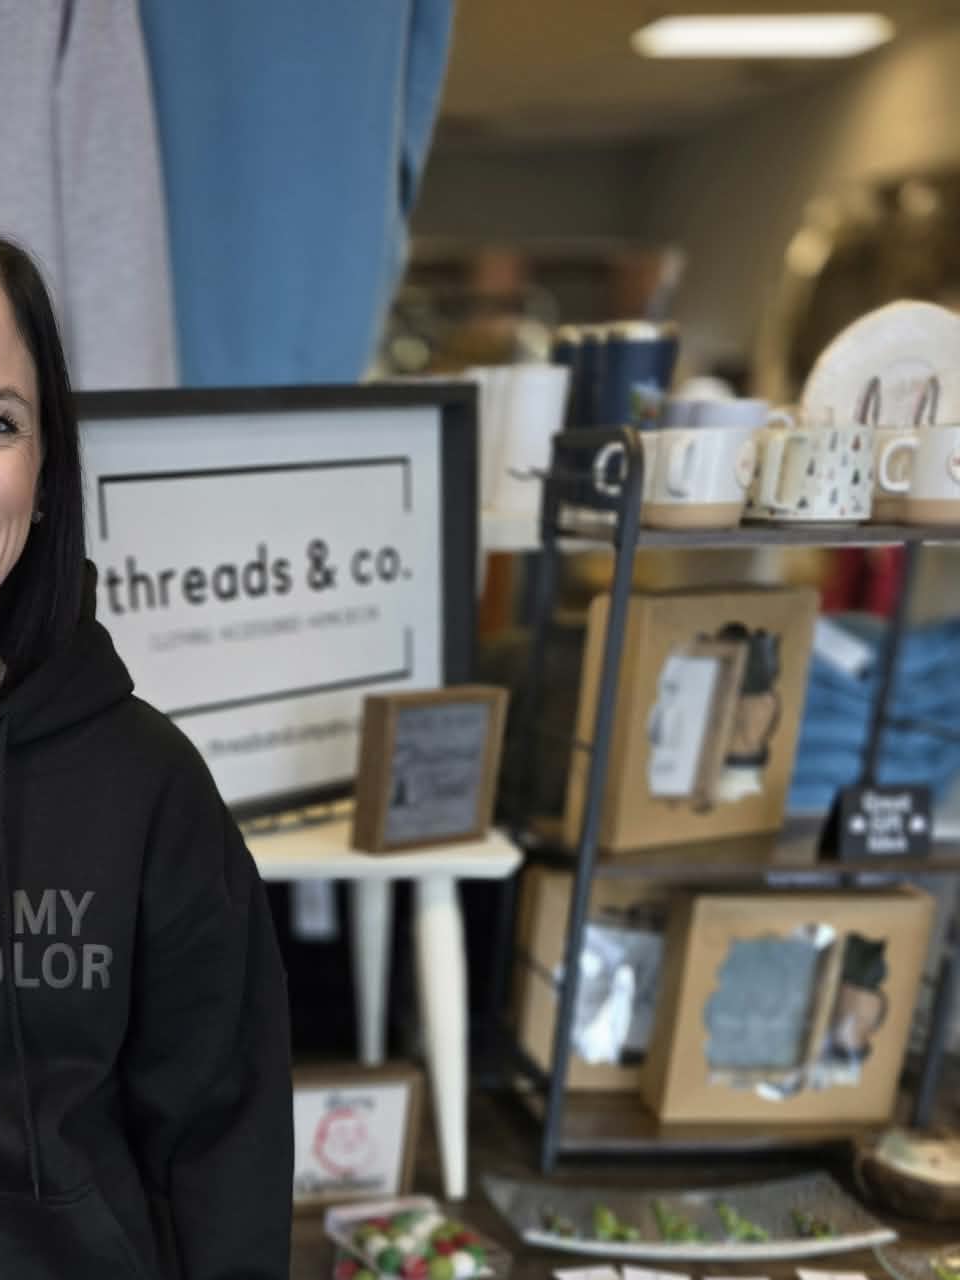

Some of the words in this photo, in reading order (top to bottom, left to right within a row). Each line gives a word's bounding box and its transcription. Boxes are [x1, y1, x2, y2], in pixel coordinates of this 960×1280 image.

[103, 543, 292, 615] threads
[306, 538, 336, 591] &
[351, 545, 412, 586] co.
[13, 889, 96, 936] MY
